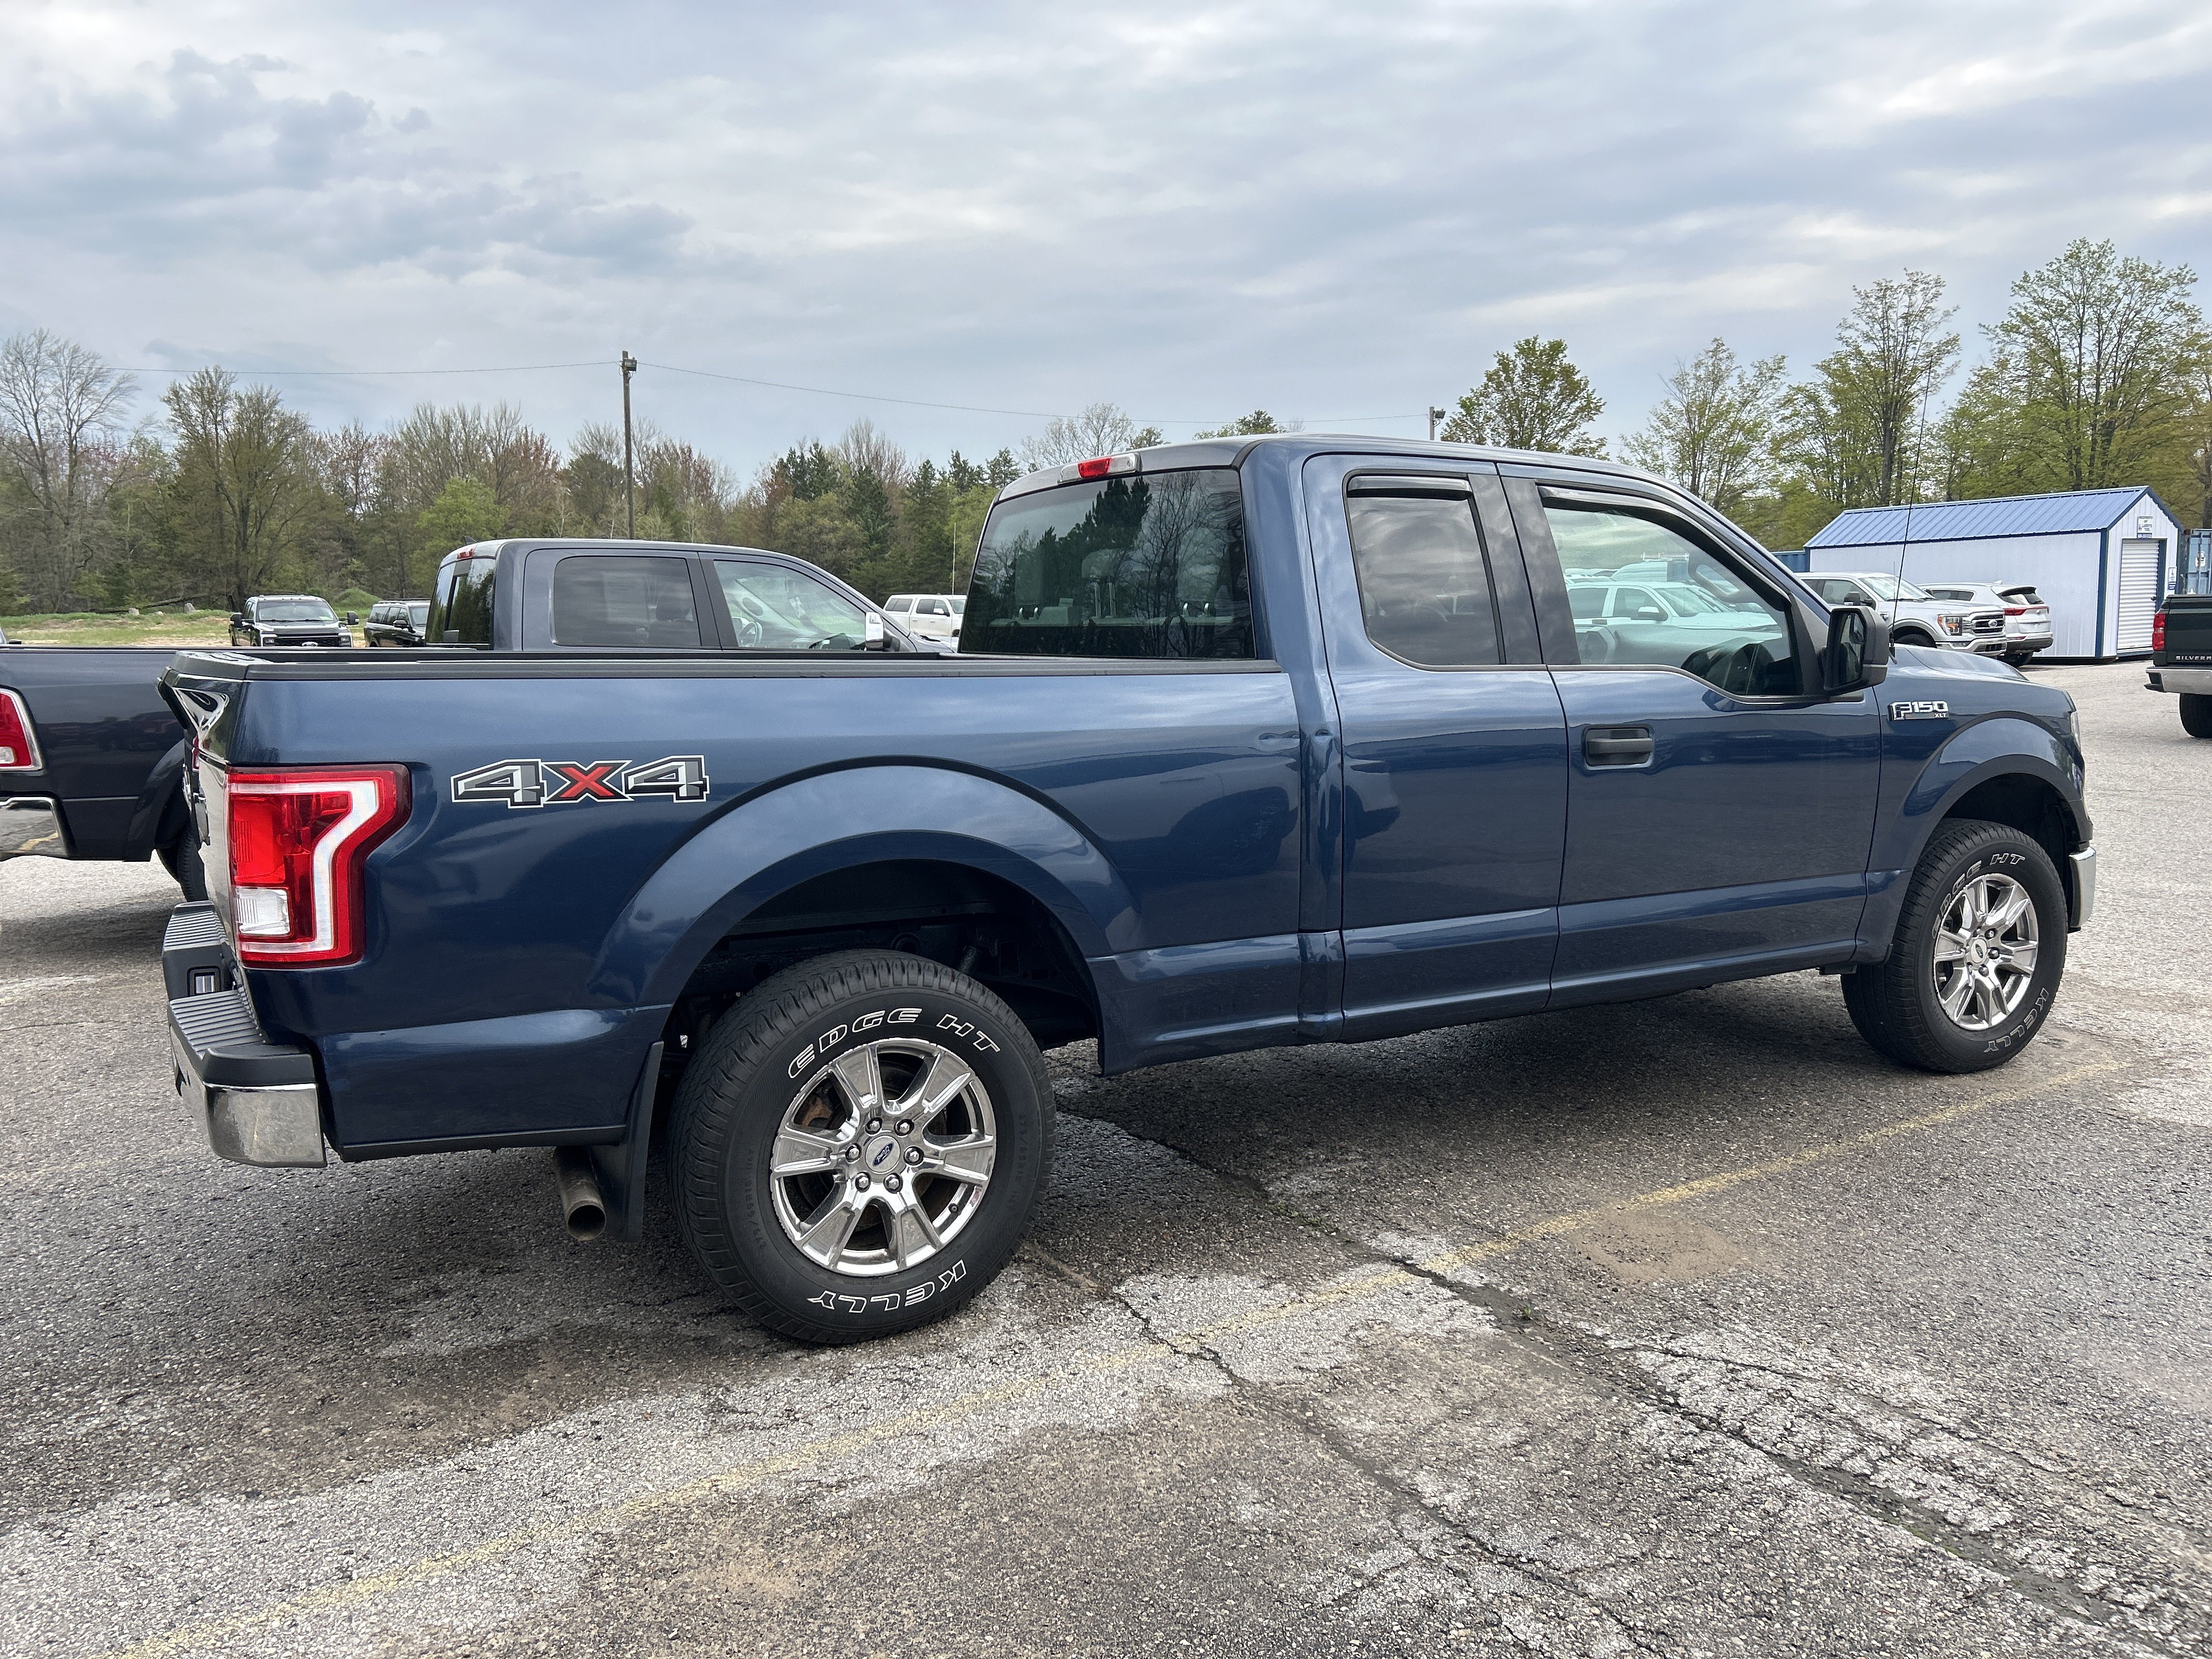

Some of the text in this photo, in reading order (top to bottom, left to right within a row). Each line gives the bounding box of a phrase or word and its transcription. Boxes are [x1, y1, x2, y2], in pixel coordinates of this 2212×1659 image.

[1989, 853, 2026, 865] HT
[788, 1008, 1001, 1079] EDGE HT
[1983, 987, 2050, 1053] KELLY
[806, 1259, 967, 1313] KELLY
